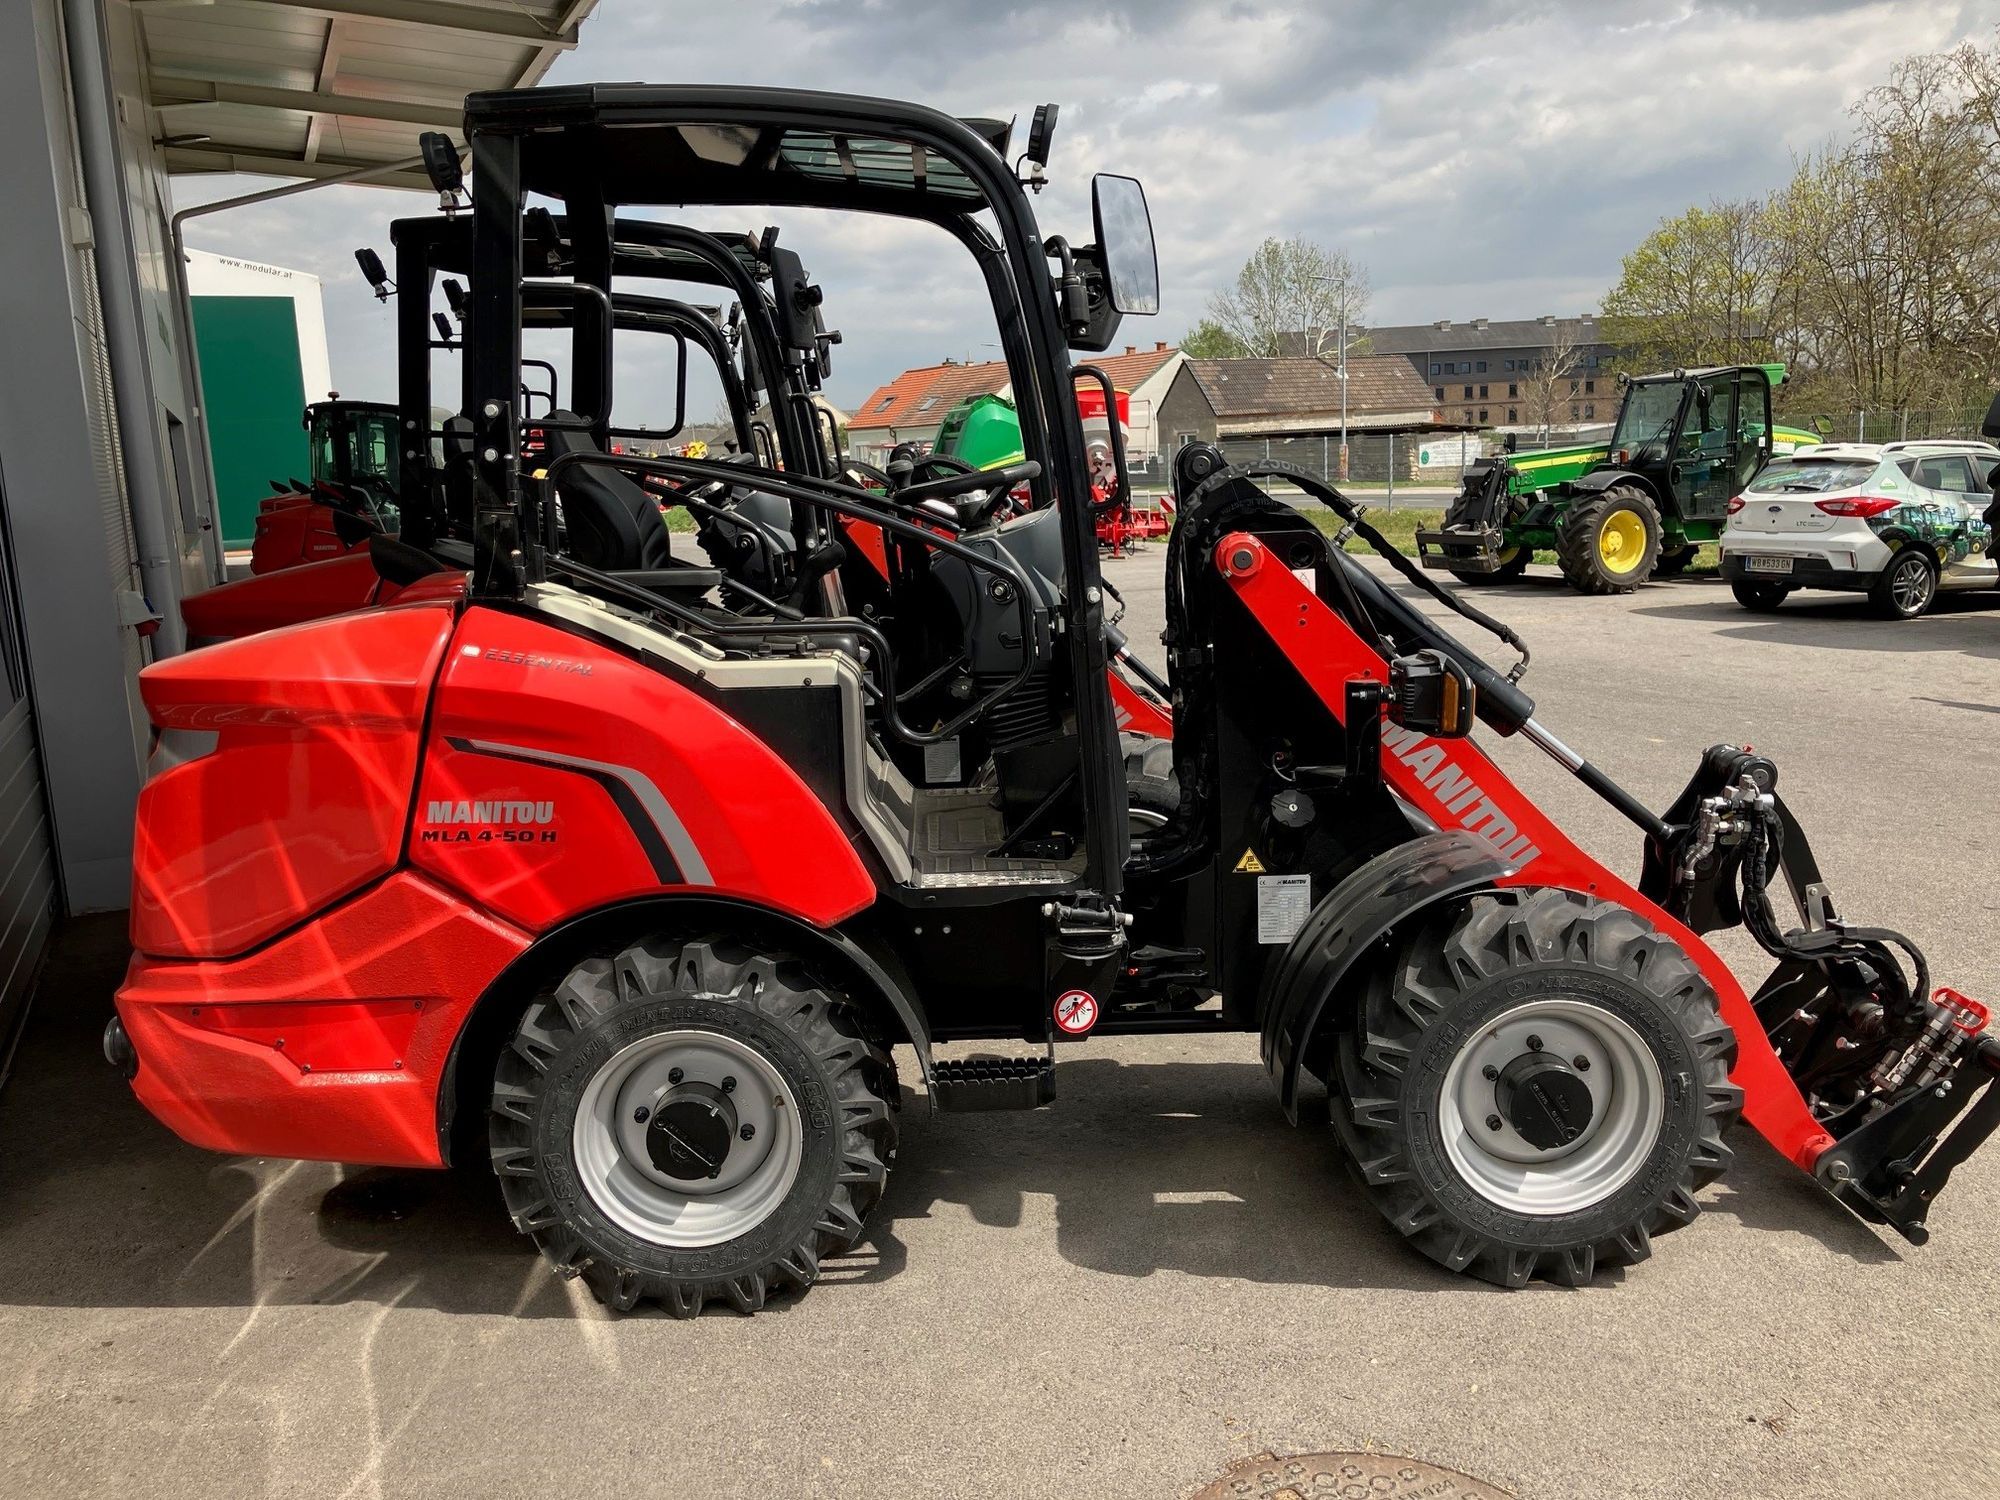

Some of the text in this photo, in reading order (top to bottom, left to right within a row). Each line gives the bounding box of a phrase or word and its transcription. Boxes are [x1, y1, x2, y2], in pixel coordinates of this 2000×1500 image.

[219, 257, 293, 279] www.modular.at
[484, 647, 593, 677] ESSENTIAL
[1381, 718, 1543, 869] MANITOU
[427, 801, 554, 824] MANITOU
[421, 830, 557, 842] MLA 4-50 H
